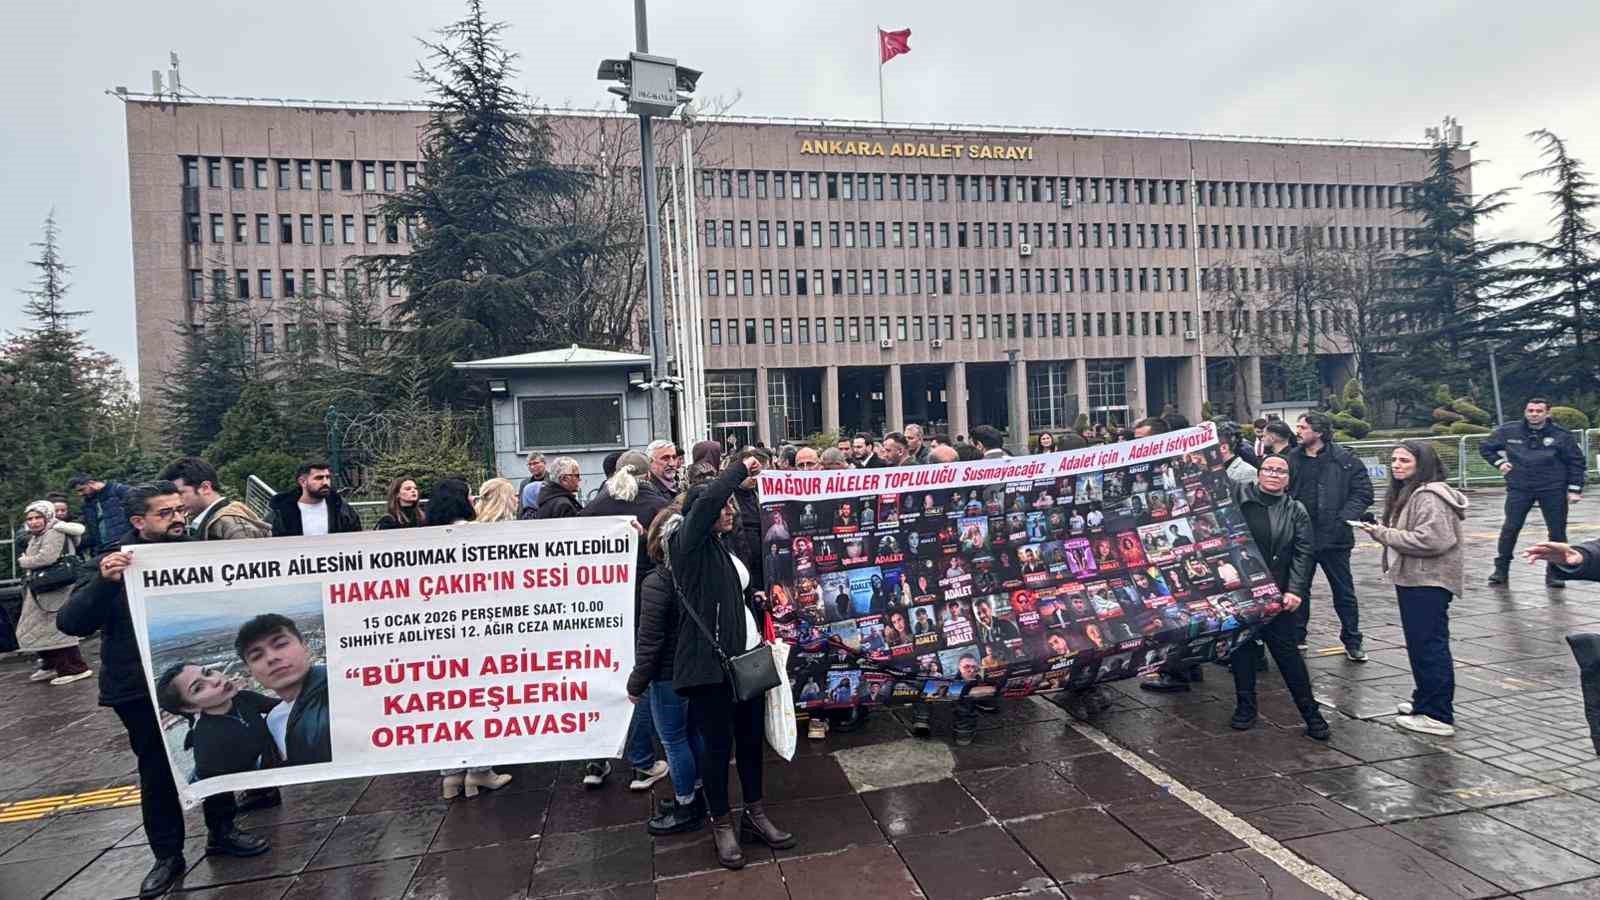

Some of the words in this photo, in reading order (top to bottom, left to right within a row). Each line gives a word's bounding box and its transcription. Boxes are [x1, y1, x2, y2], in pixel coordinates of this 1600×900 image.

[800, 140, 885, 156] ANKARA
[890, 142, 963, 158] ADALET
[969, 145, 1033, 160] SARAYI
[761, 473, 821, 496] MAĞDUR
[826, 472, 880, 492] AİLELER
[884, 465, 957, 489] TOPLULUĞU
[963, 460, 1046, 482] Susmayacağız
[1059, 453, 1096, 471] Adalet
[1097, 448, 1119, 468] için
[1128, 440, 1164, 461] Adalet
[1166, 428, 1214, 453] istiyoruz
[142, 566, 214, 587] HAKAN
[221, 561, 281, 585] ÇAKIR
[287, 551, 363, 575] AİLESİNİ
[369, 548, 457, 569] KORUMAK
[462, 543, 539, 562] İSTERKEN
[545, 535, 630, 556] KATLEDİLDİ
[875, 553, 904, 564] ADALET
[330, 579, 410, 603] HAKAN
[419, 571, 515, 601] ÇAKIR'IN
[523, 563, 569, 588] SESİ
[576, 565, 629, 585] OLUN
[944, 585, 972, 601] ADALET
[363, 617, 380, 629] 15
[384, 613, 421, 627] OCAK
[424, 611, 457, 623] 2026
[462, 603, 530, 621] PERŞEMBE
[532, 602, 567, 615] SAAT:
[571, 601, 604, 612] 10.00
[339, 633, 394, 648] SIHHİYE
[398, 628, 456, 643] ADLİYESİ
[461, 626, 480, 637] 12.
[484, 623, 514, 635] AĞIR
[517, 621, 549, 633] CEZA
[552, 617, 624, 630] MAHKEMESİ
[947, 632, 973, 647] ADALET
[345, 655, 469, 686] “BÜTÜN
[479, 645, 619, 679] ABİLERİN,
[383, 677, 588, 715] KARDEŞLERİN
[371, 720, 474, 747] ORTAK
[484, 712, 600, 738] DAVASI”
